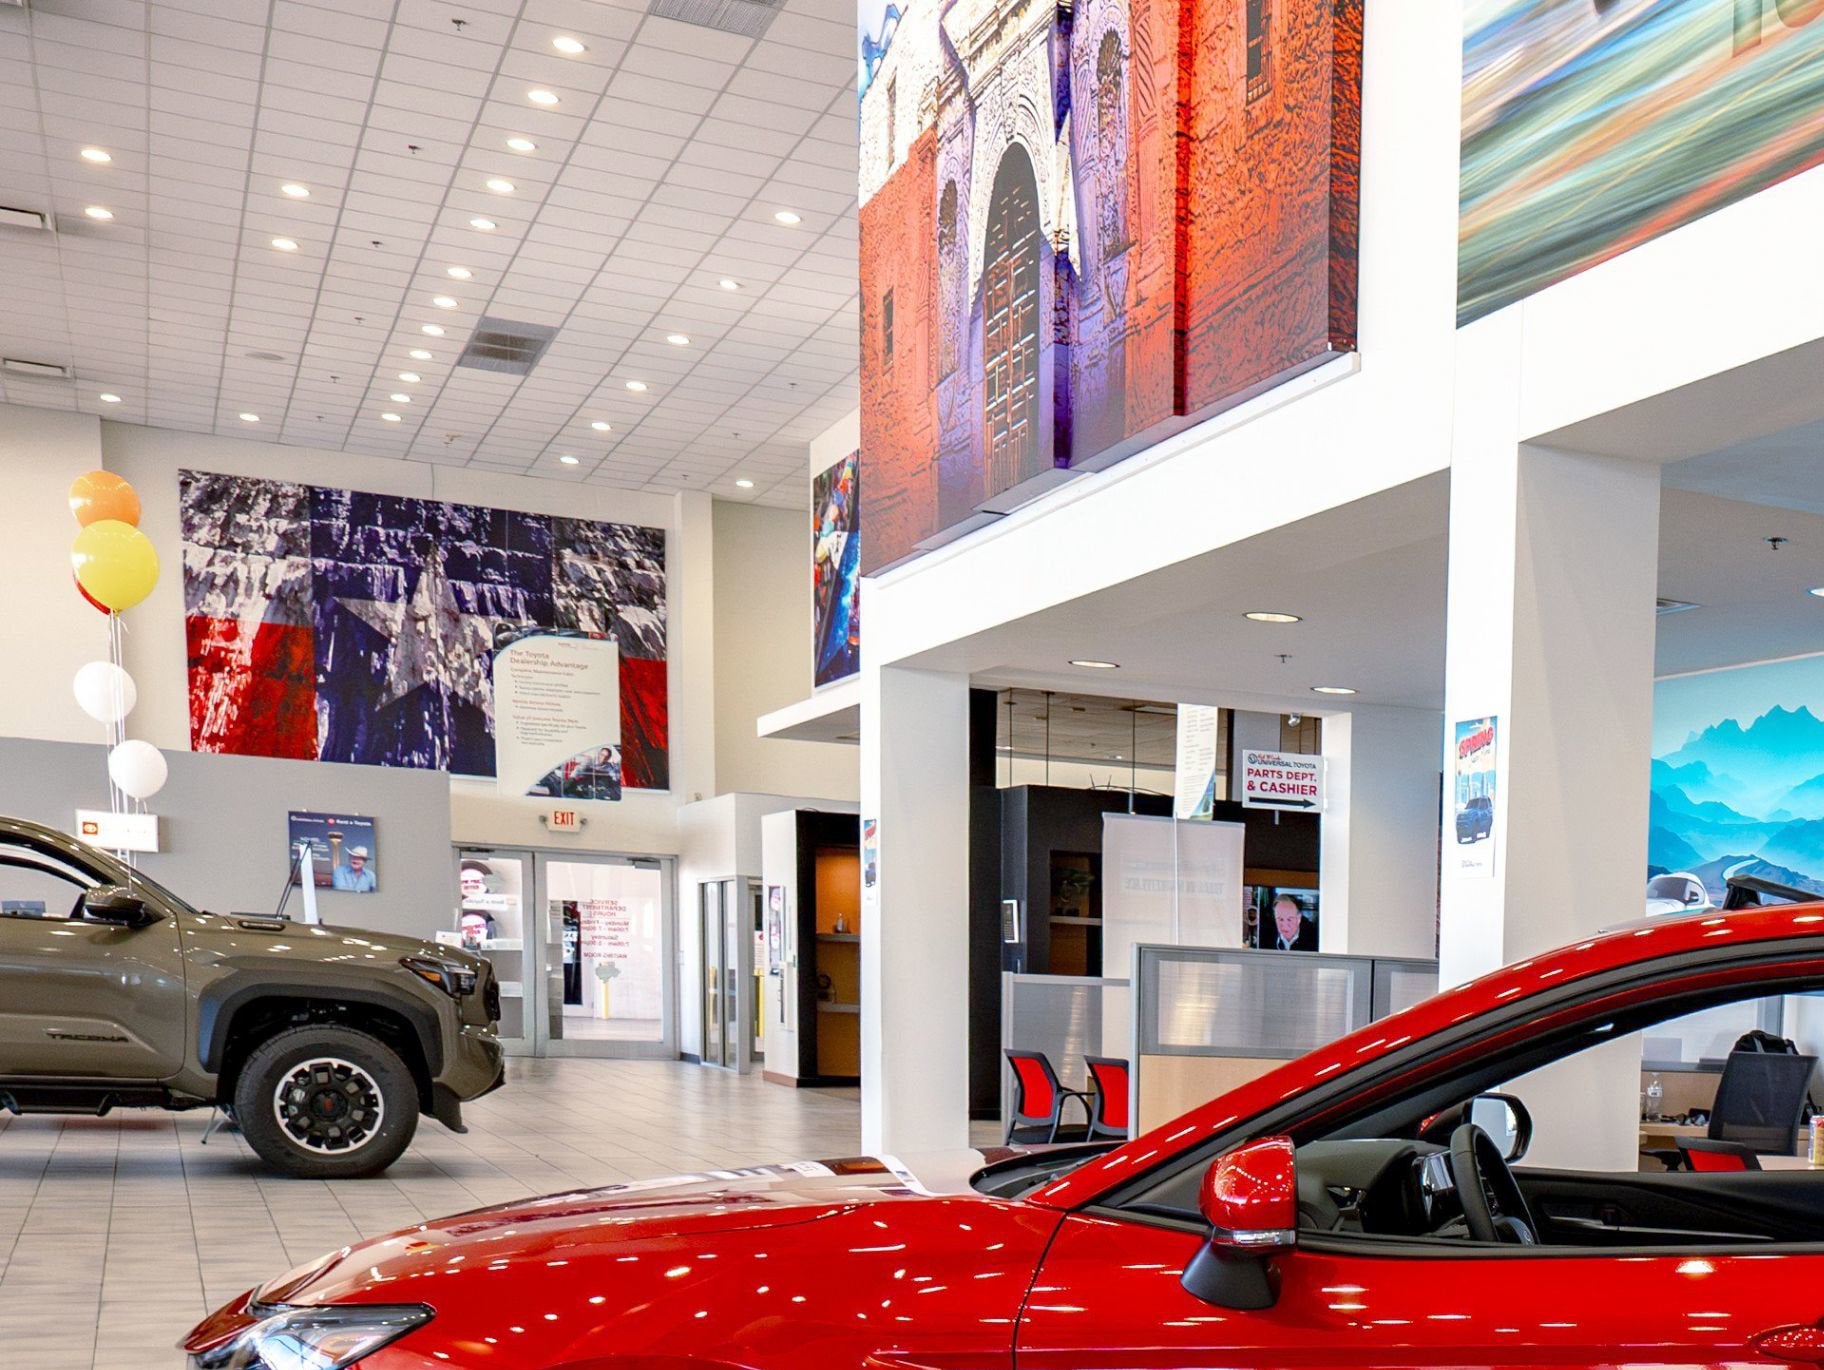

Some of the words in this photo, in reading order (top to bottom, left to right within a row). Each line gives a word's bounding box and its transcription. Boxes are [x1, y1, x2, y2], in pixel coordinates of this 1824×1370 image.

[526, 650, 549, 659] Toyota
[510, 657, 548, 667] Dealership
[550, 660, 589, 670] Advantage
[1459, 727, 1493, 759] SPRING
[1257, 759, 1293, 768] UNIVERSAL
[1293, 761, 1317, 769] TOYOTA
[1247, 768, 1283, 779] PARTS
[1286, 771, 1317, 782] DEPT.
[1247, 780, 1256, 791] &
[1260, 781, 1317, 796] CASHIER
[554, 810, 575, 825] EXIT
